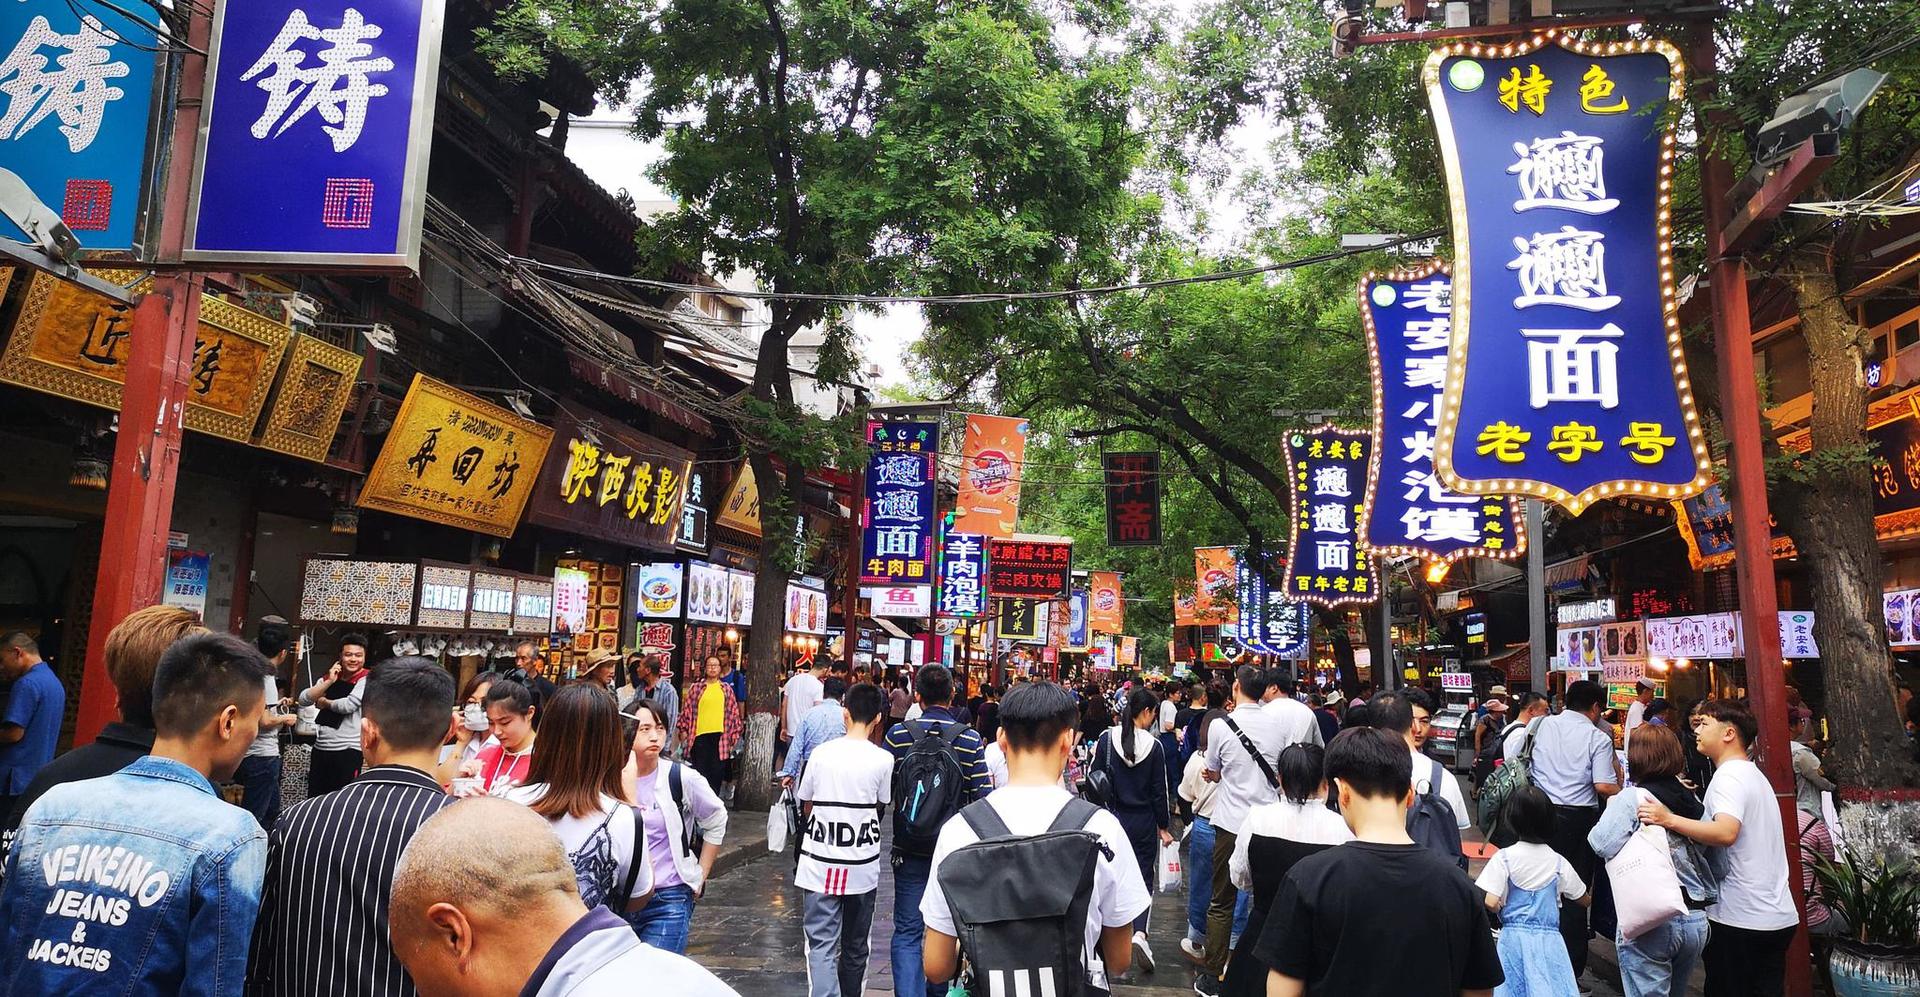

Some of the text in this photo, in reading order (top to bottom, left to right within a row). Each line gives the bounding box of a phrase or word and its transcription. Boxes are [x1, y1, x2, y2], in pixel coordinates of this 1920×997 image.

[240, 8, 395, 153] 铸
[1498, 64, 1629, 115] 特色
[1868, 365, 1880, 385] 坊
[1308, 438, 1363, 459] 老安家
[1477, 421, 1677, 464] 老字号
[407, 427, 520, 499] 再回坊
[562, 438, 679, 525] 陕西皮影
[867, 559, 925, 577] 牛肉面
[1295, 576, 1369, 593] 百年老店
[806, 814, 880, 848] ADIDAS
[43, 844, 169, 908] VEIKEINO
[45, 888, 131, 926] JEANS
[71, 921, 86, 943] &
